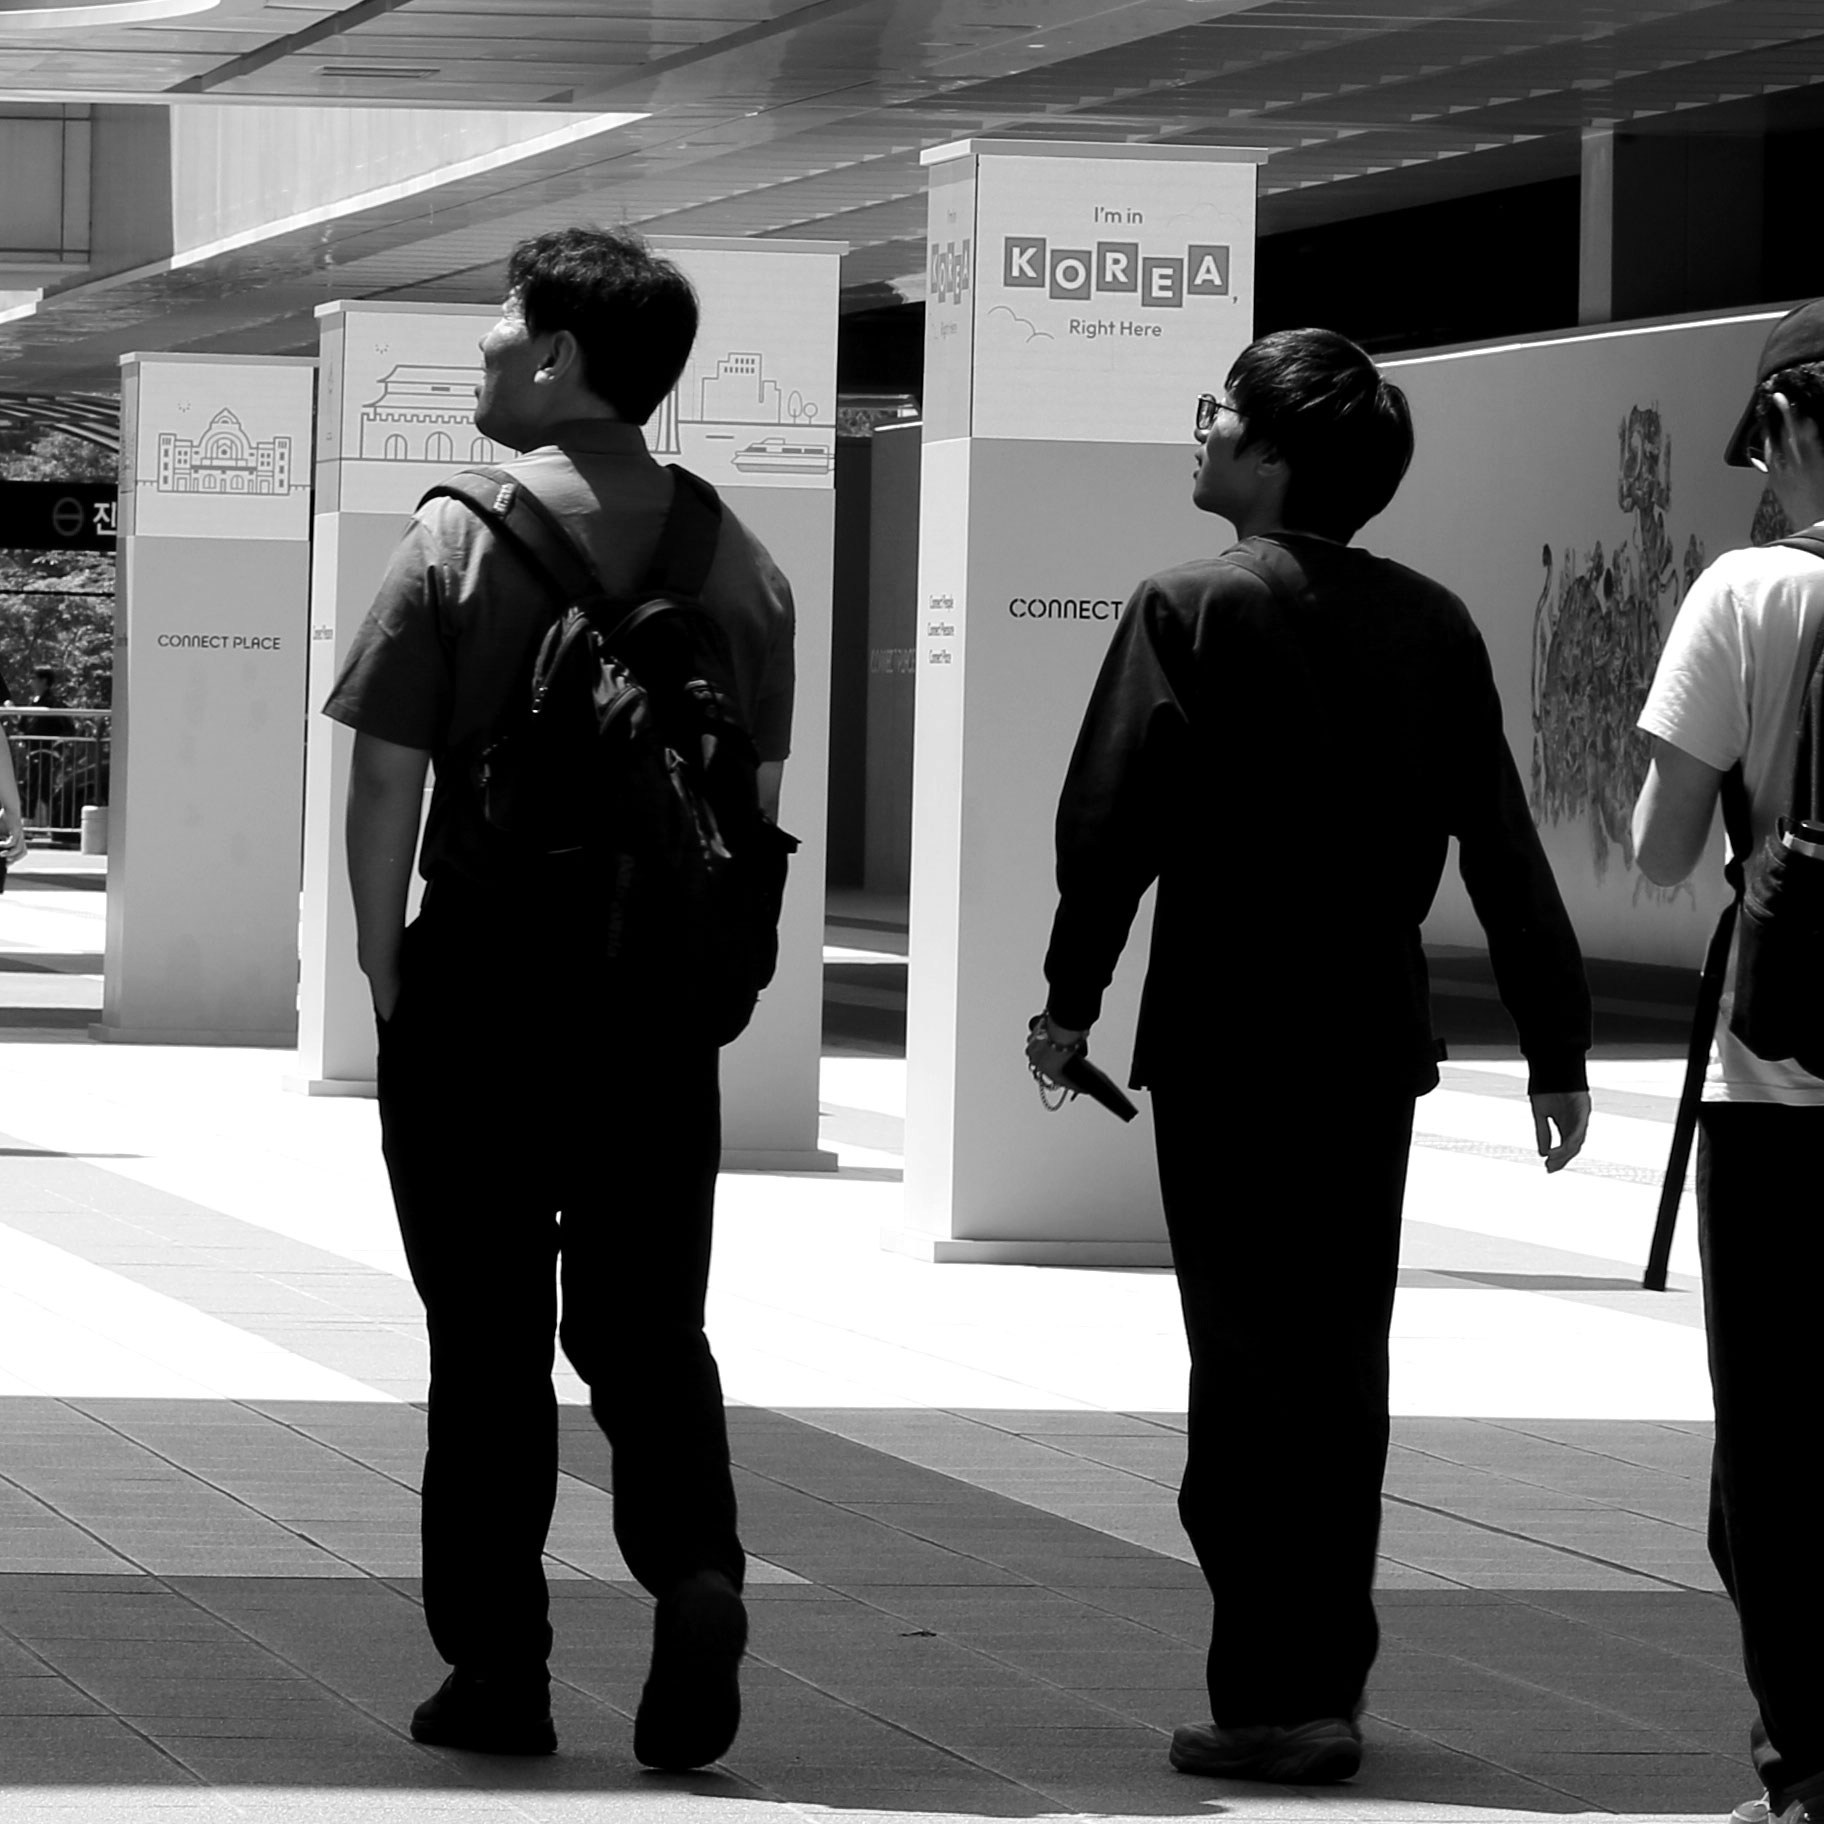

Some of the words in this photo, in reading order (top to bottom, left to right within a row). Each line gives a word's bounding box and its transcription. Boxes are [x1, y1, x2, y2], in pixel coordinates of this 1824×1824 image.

[1126, 206, 1144, 225] in
[1068, 318, 1115, 339] Right
[1119, 320, 1163, 338] Here
[1009, 596, 1123, 621] CONNECT
[158, 634, 229, 650] CONNECT
[232, 635, 281, 651] PLACE
